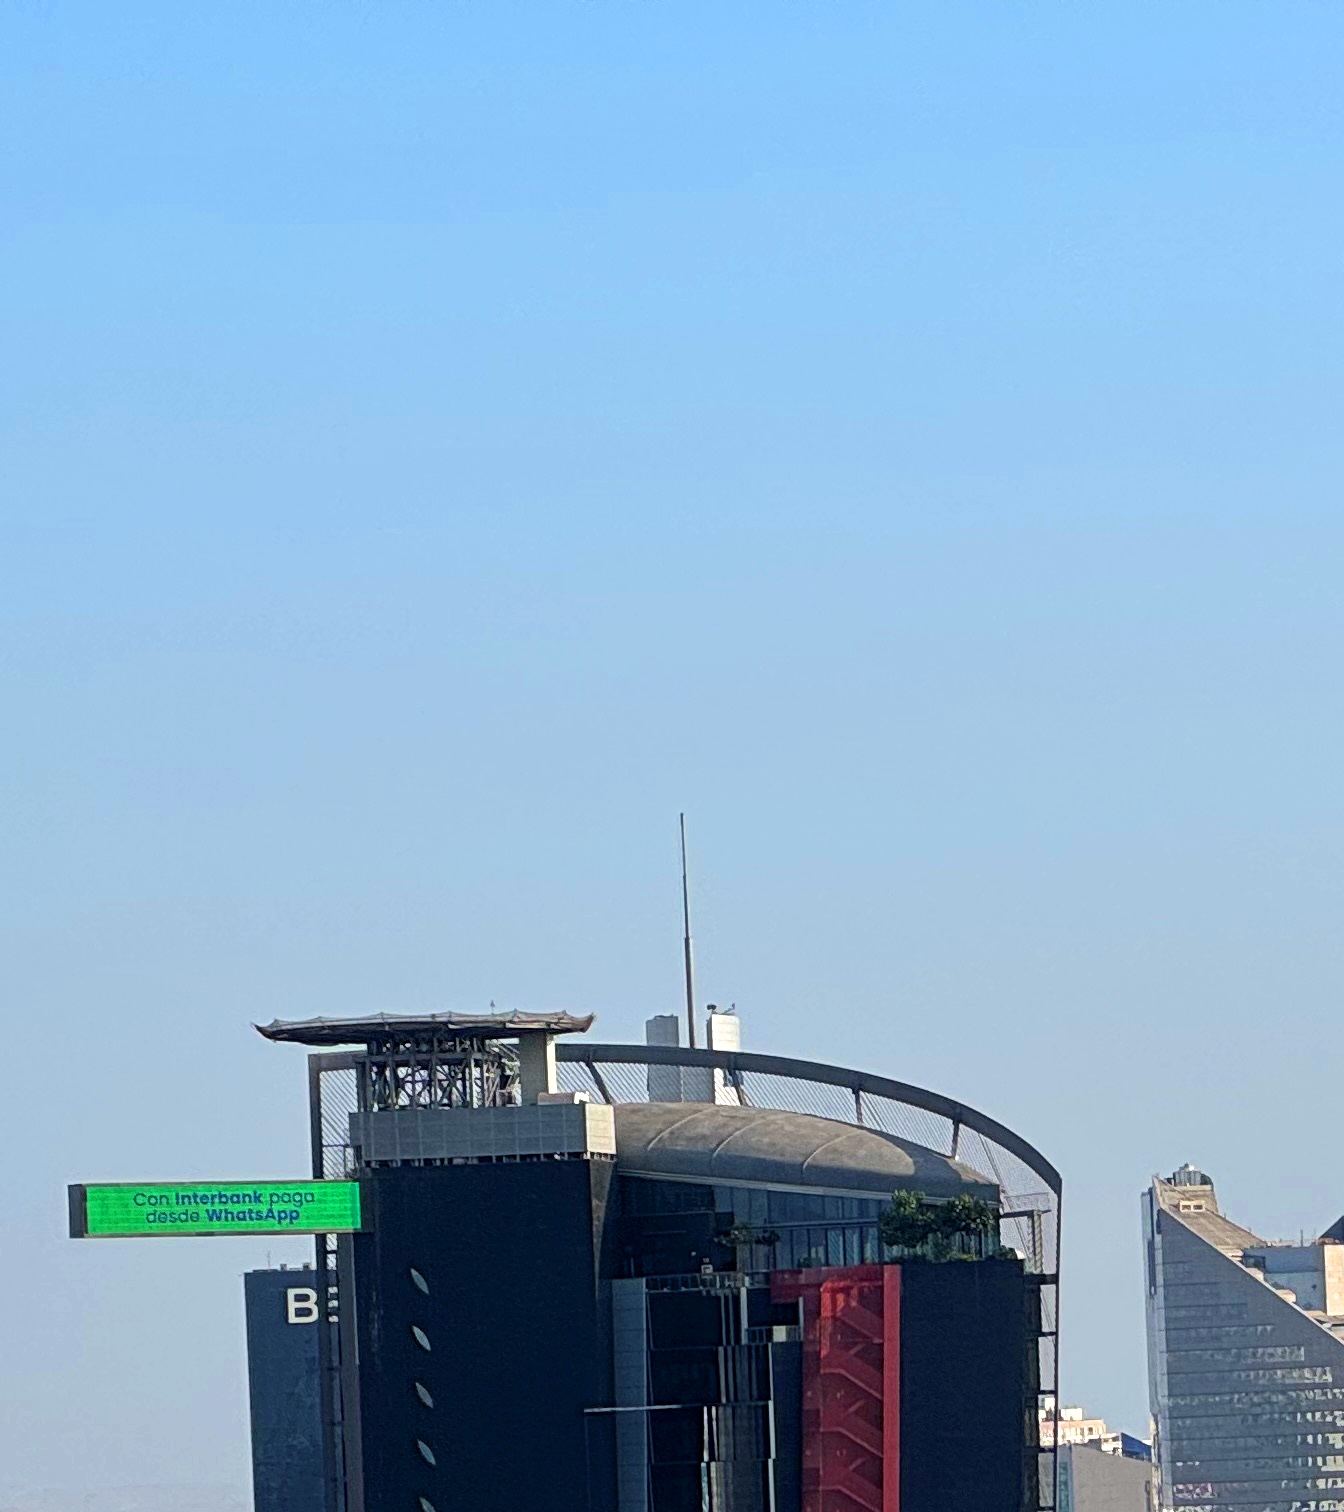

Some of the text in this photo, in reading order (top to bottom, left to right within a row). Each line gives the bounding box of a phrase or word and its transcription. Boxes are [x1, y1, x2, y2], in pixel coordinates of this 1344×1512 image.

[132, 1190, 315, 1207] Con Interbank paga
[146, 1207, 300, 1224] desde WhatsApp
